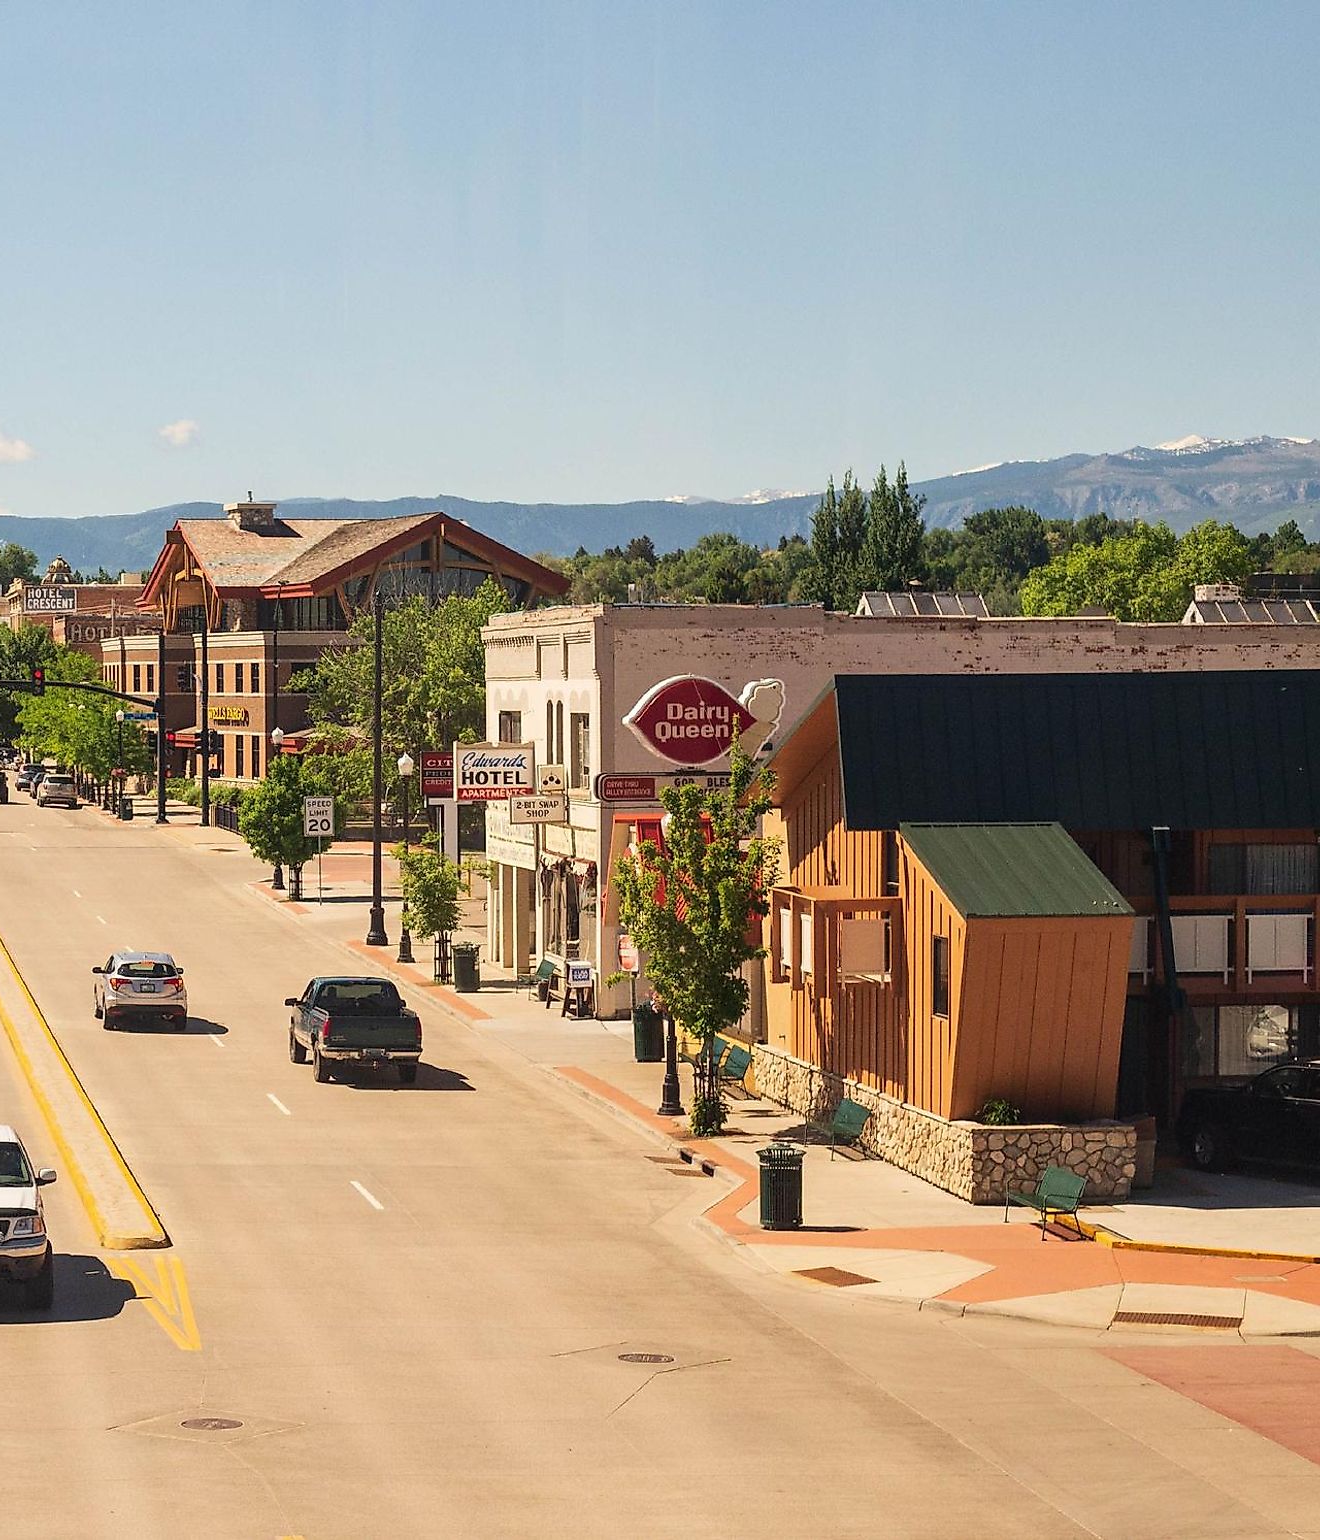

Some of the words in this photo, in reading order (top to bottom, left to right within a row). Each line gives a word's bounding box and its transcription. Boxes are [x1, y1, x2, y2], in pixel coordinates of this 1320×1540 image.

[27, 588, 62, 599] HOTEL
[27, 599, 74, 609] CRESCENT
[667, 701, 729, 722] Dairy
[655, 722, 729, 742] Queen
[426, 759, 452, 767] CIT
[462, 752, 528, 771] Edwards
[462, 771, 527, 785] HOTEL
[674, 777, 695, 788] GOD
[707, 777, 731, 788] BLES
[461, 788, 527, 799] APARTMENTS
[516, 801, 536, 809] 2-BIT
[539, 801, 559, 809] SWAP
[526, 810, 550, 818] SHOP
[309, 819, 330, 831] 20
